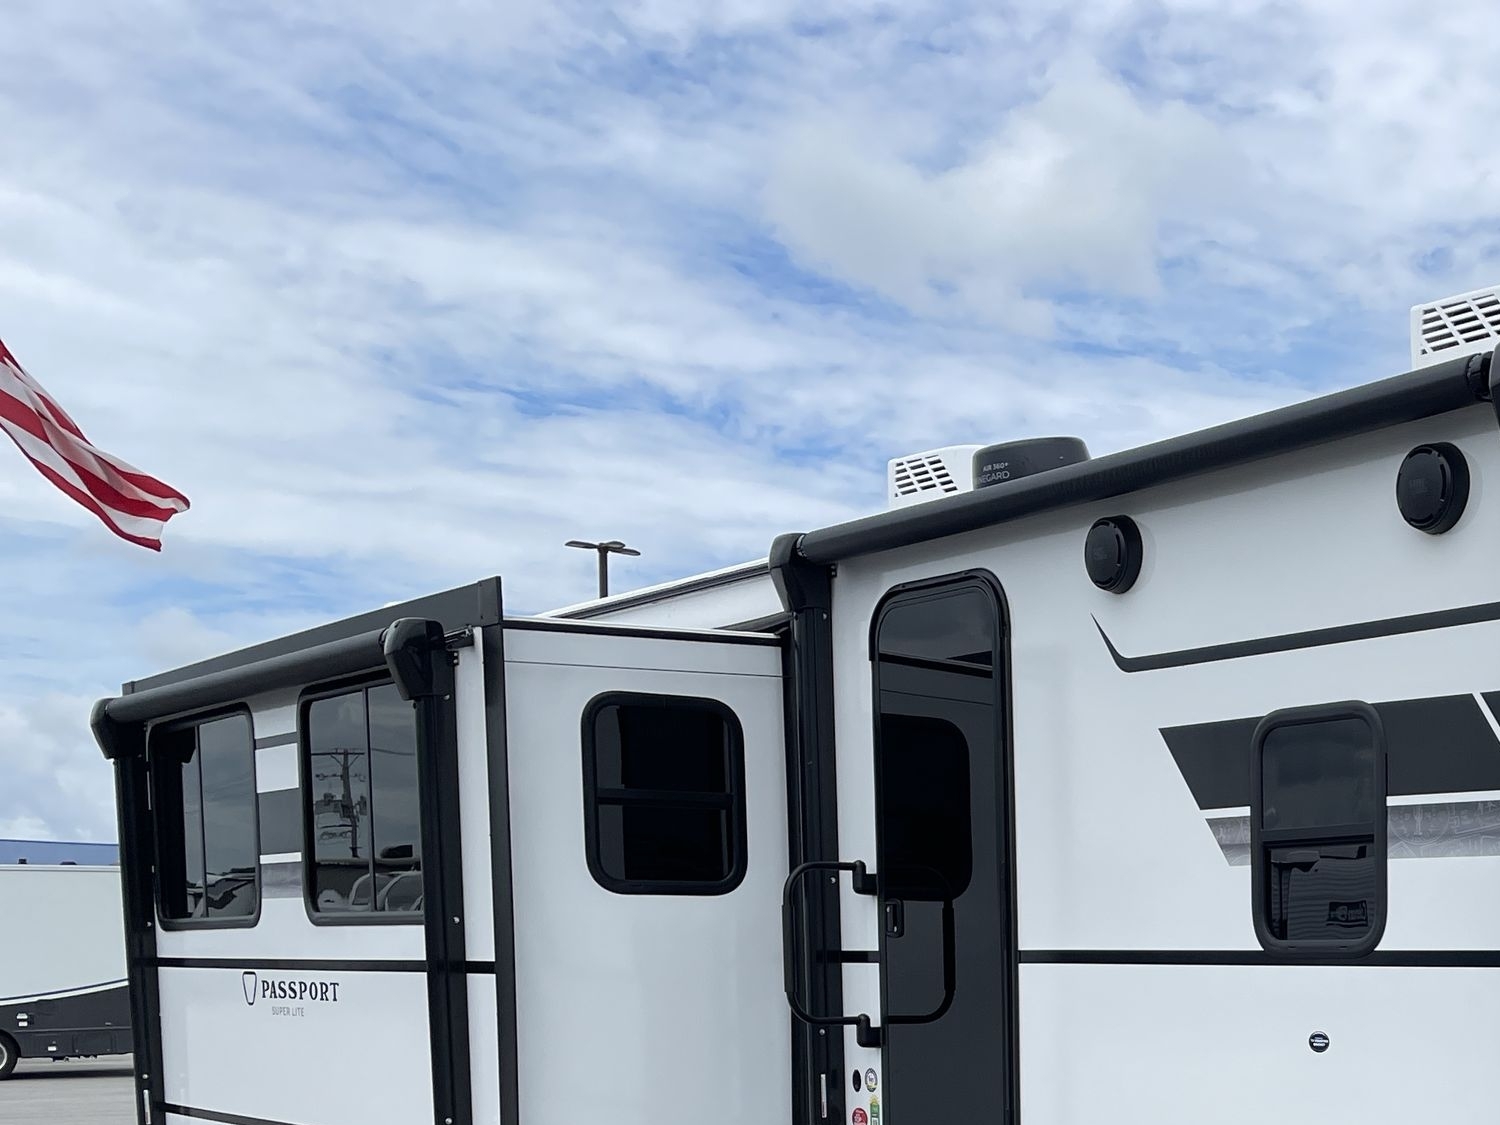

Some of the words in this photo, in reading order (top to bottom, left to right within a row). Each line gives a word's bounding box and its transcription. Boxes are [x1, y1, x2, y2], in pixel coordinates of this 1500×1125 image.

[261, 980, 339, 1002] PASSPORT
[271, 1006, 290, 1016] SUPER
[292, 1007, 304, 1017] LITE
